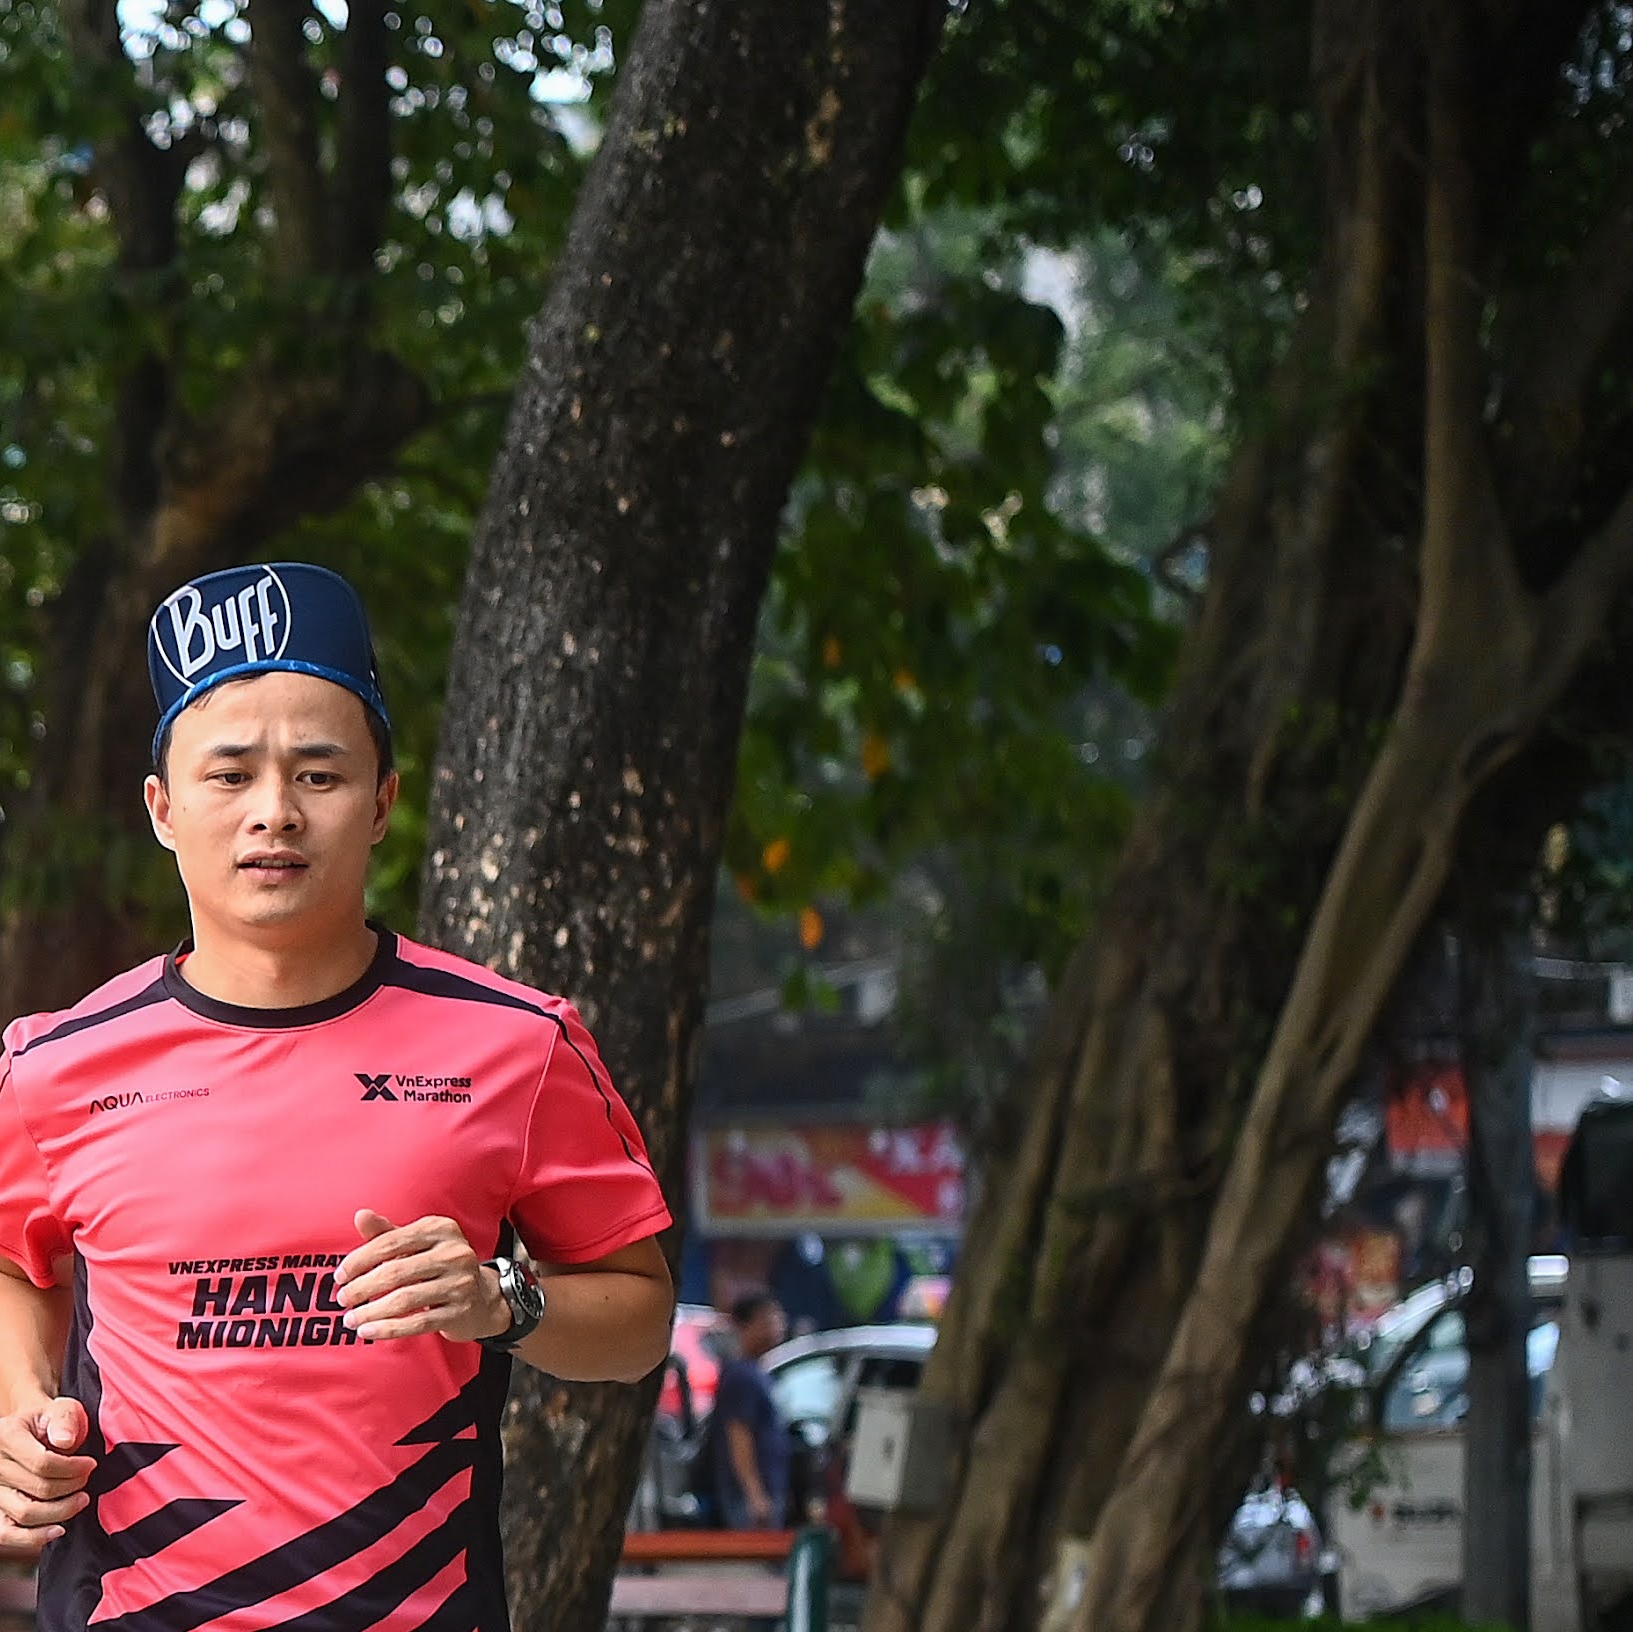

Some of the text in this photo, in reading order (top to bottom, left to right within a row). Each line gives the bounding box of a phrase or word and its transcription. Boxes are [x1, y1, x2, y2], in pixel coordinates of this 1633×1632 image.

[395, 1074, 472, 1090] VnExpress
[89, 1088, 210, 1115] AQUA ELECTRONICS
[403, 1088, 472, 1105] Marathon
[168, 1254, 347, 1275] VNEXPRESS MARA
[191, 1272, 357, 1317] HANO
[176, 1315, 374, 1349] MIDNIGH
